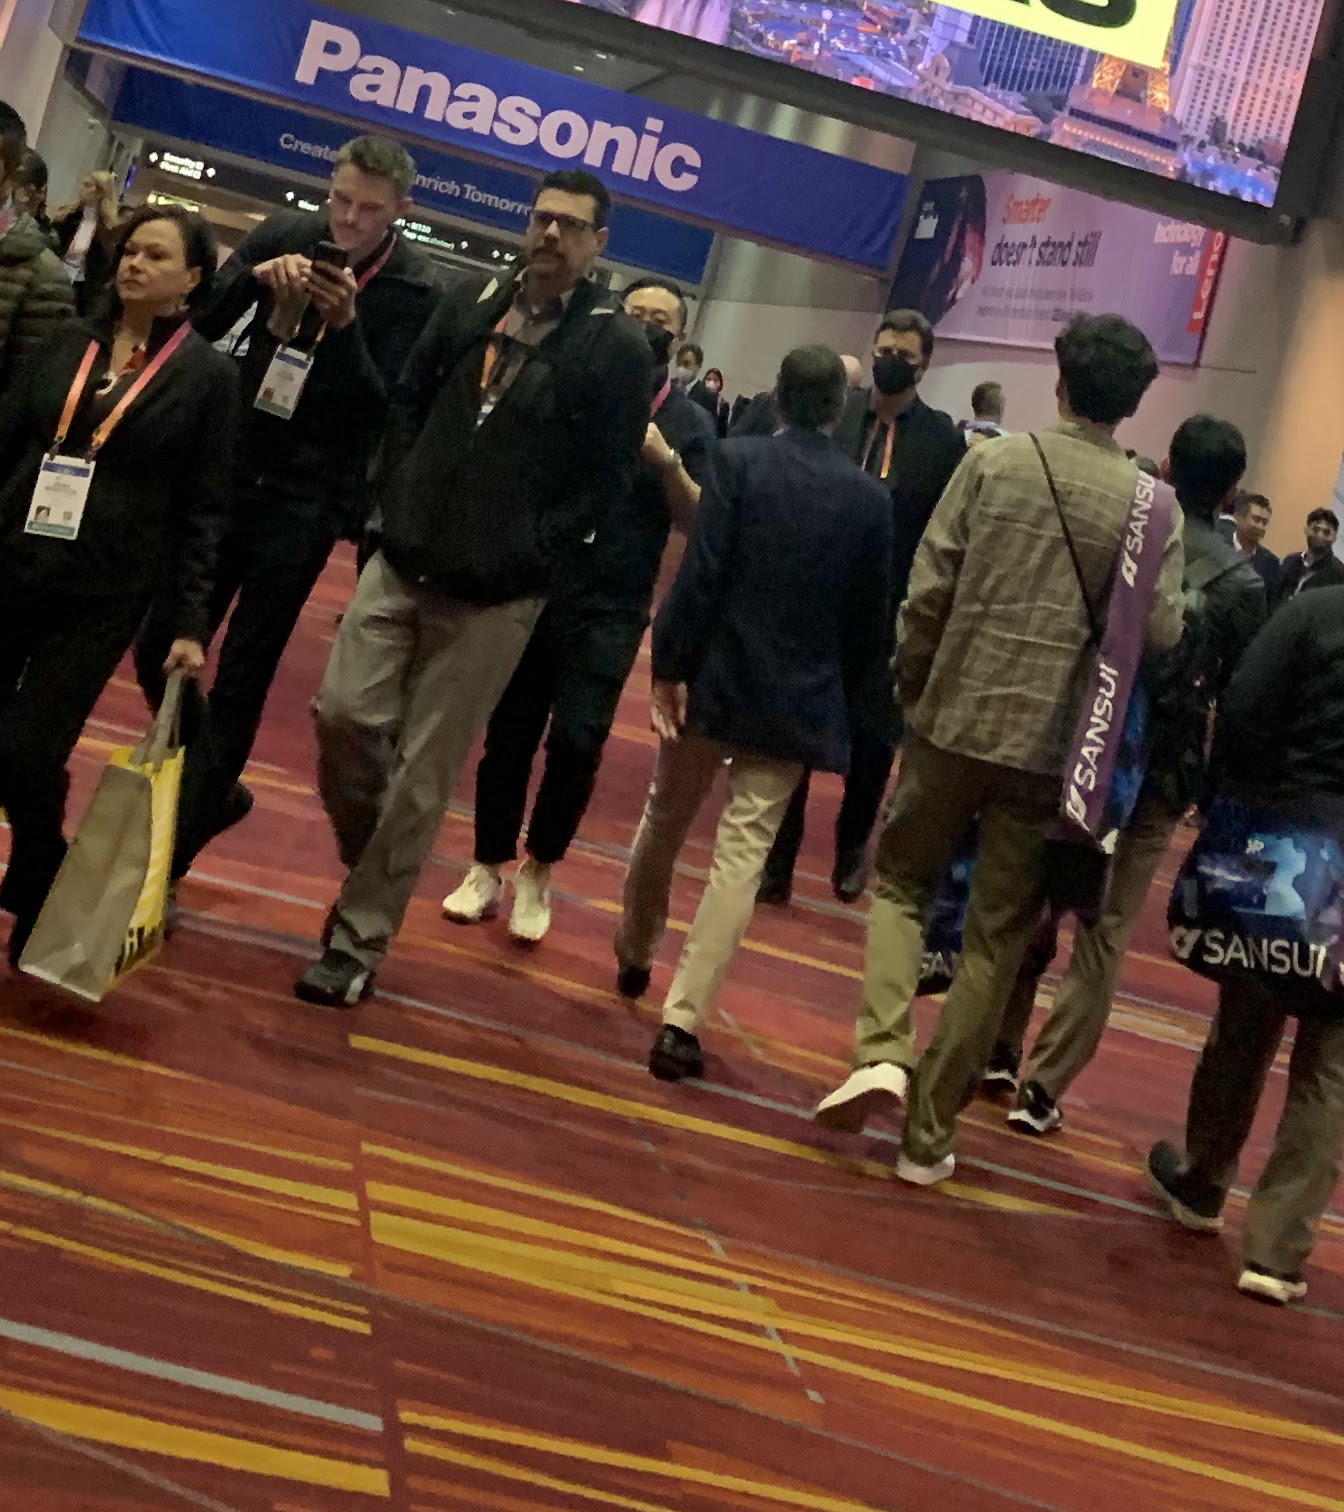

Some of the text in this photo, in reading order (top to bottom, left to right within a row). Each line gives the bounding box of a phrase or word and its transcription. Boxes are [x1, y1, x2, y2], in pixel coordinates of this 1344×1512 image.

[294, 19, 702, 192] Panasonic
[414, 170, 461, 198] nrich
[1002, 193, 1052, 225] Smarter
[1035, 231, 1074, 267] stand
[1073, 230, 1103, 267] still
[1125, 470, 1157, 555] SANSU
[1074, 662, 1119, 792] SANSUI
[1202, 932, 1328, 980] SANSUI
